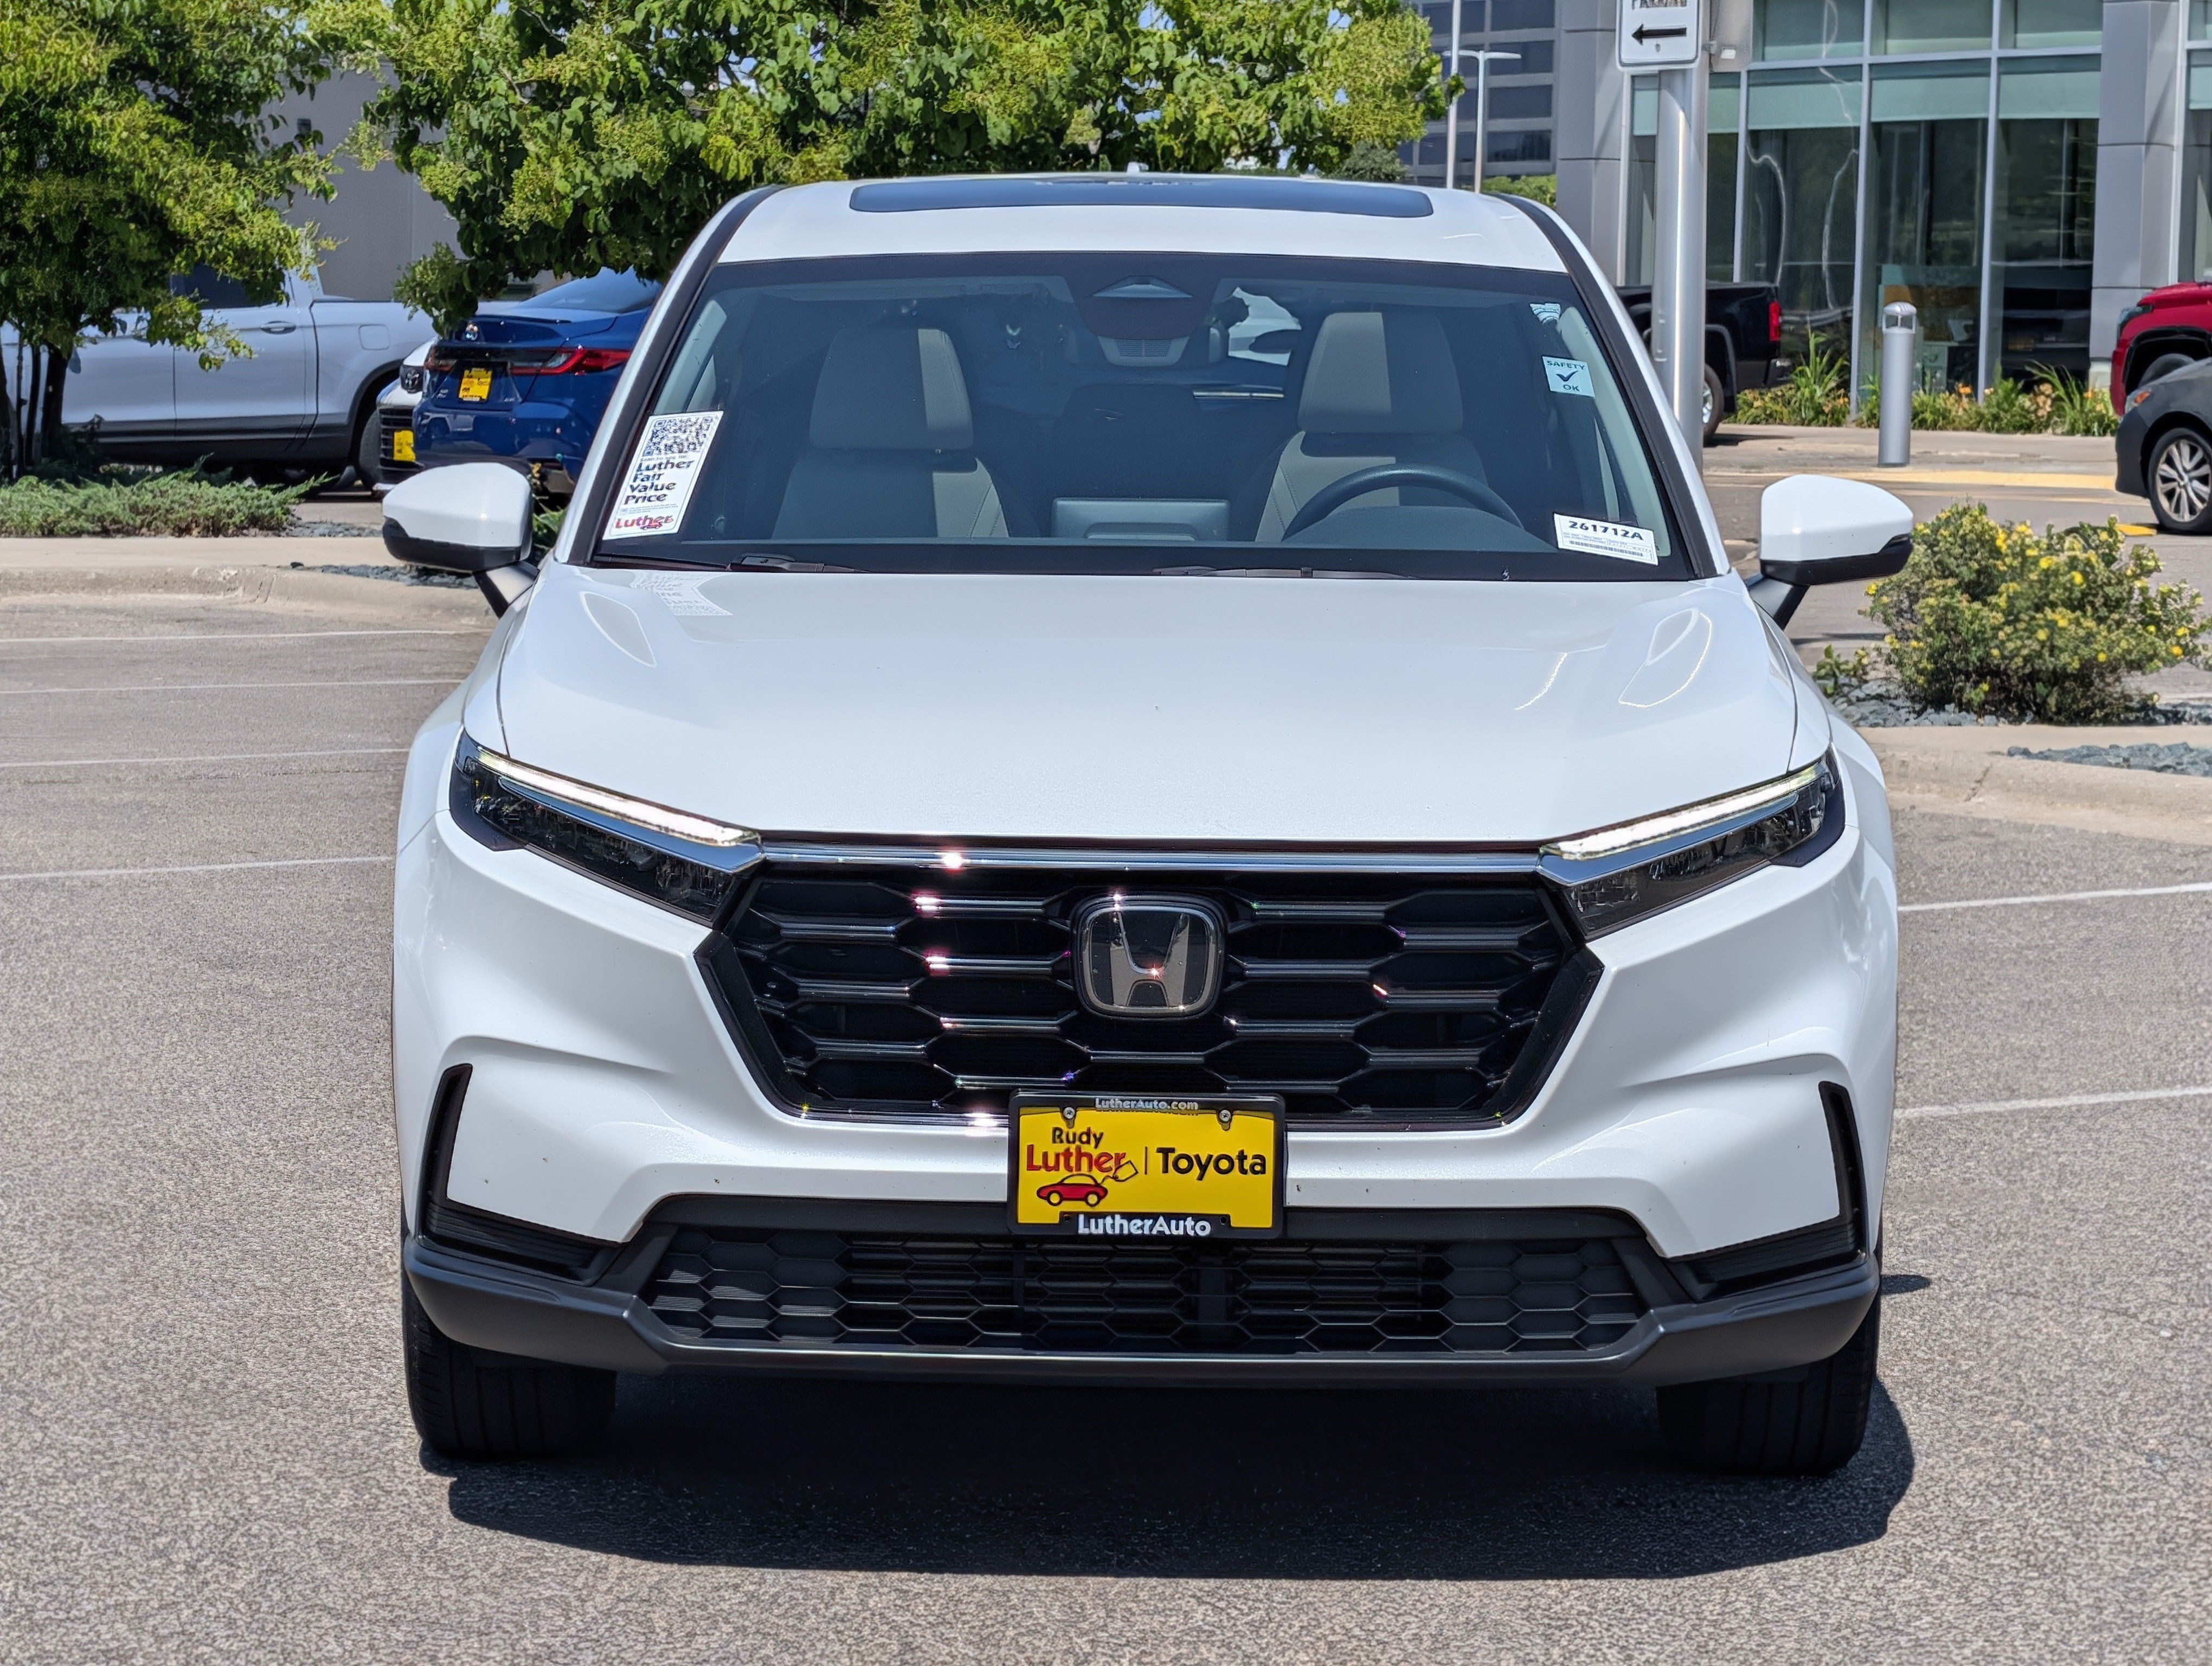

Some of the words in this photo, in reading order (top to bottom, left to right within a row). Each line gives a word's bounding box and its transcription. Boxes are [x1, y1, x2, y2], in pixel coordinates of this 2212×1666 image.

[1547, 361, 1585, 370] SAFETY
[636, 459, 695, 472] Luther
[633, 471, 665, 483] Fair
[629, 482, 677, 494] Value
[624, 492, 668, 505] Price
[615, 515, 674, 529] Luther
[1568, 521, 1644, 541] 261712A
[1095, 1098, 1198, 1110] LutherAuto.com
[1052, 1126, 1104, 1149] Rudy
[1026, 1144, 1126, 1173] Luther
[1156, 1147, 1266, 1181] Toyota
[1078, 1213, 1212, 1236] LutherAuto
